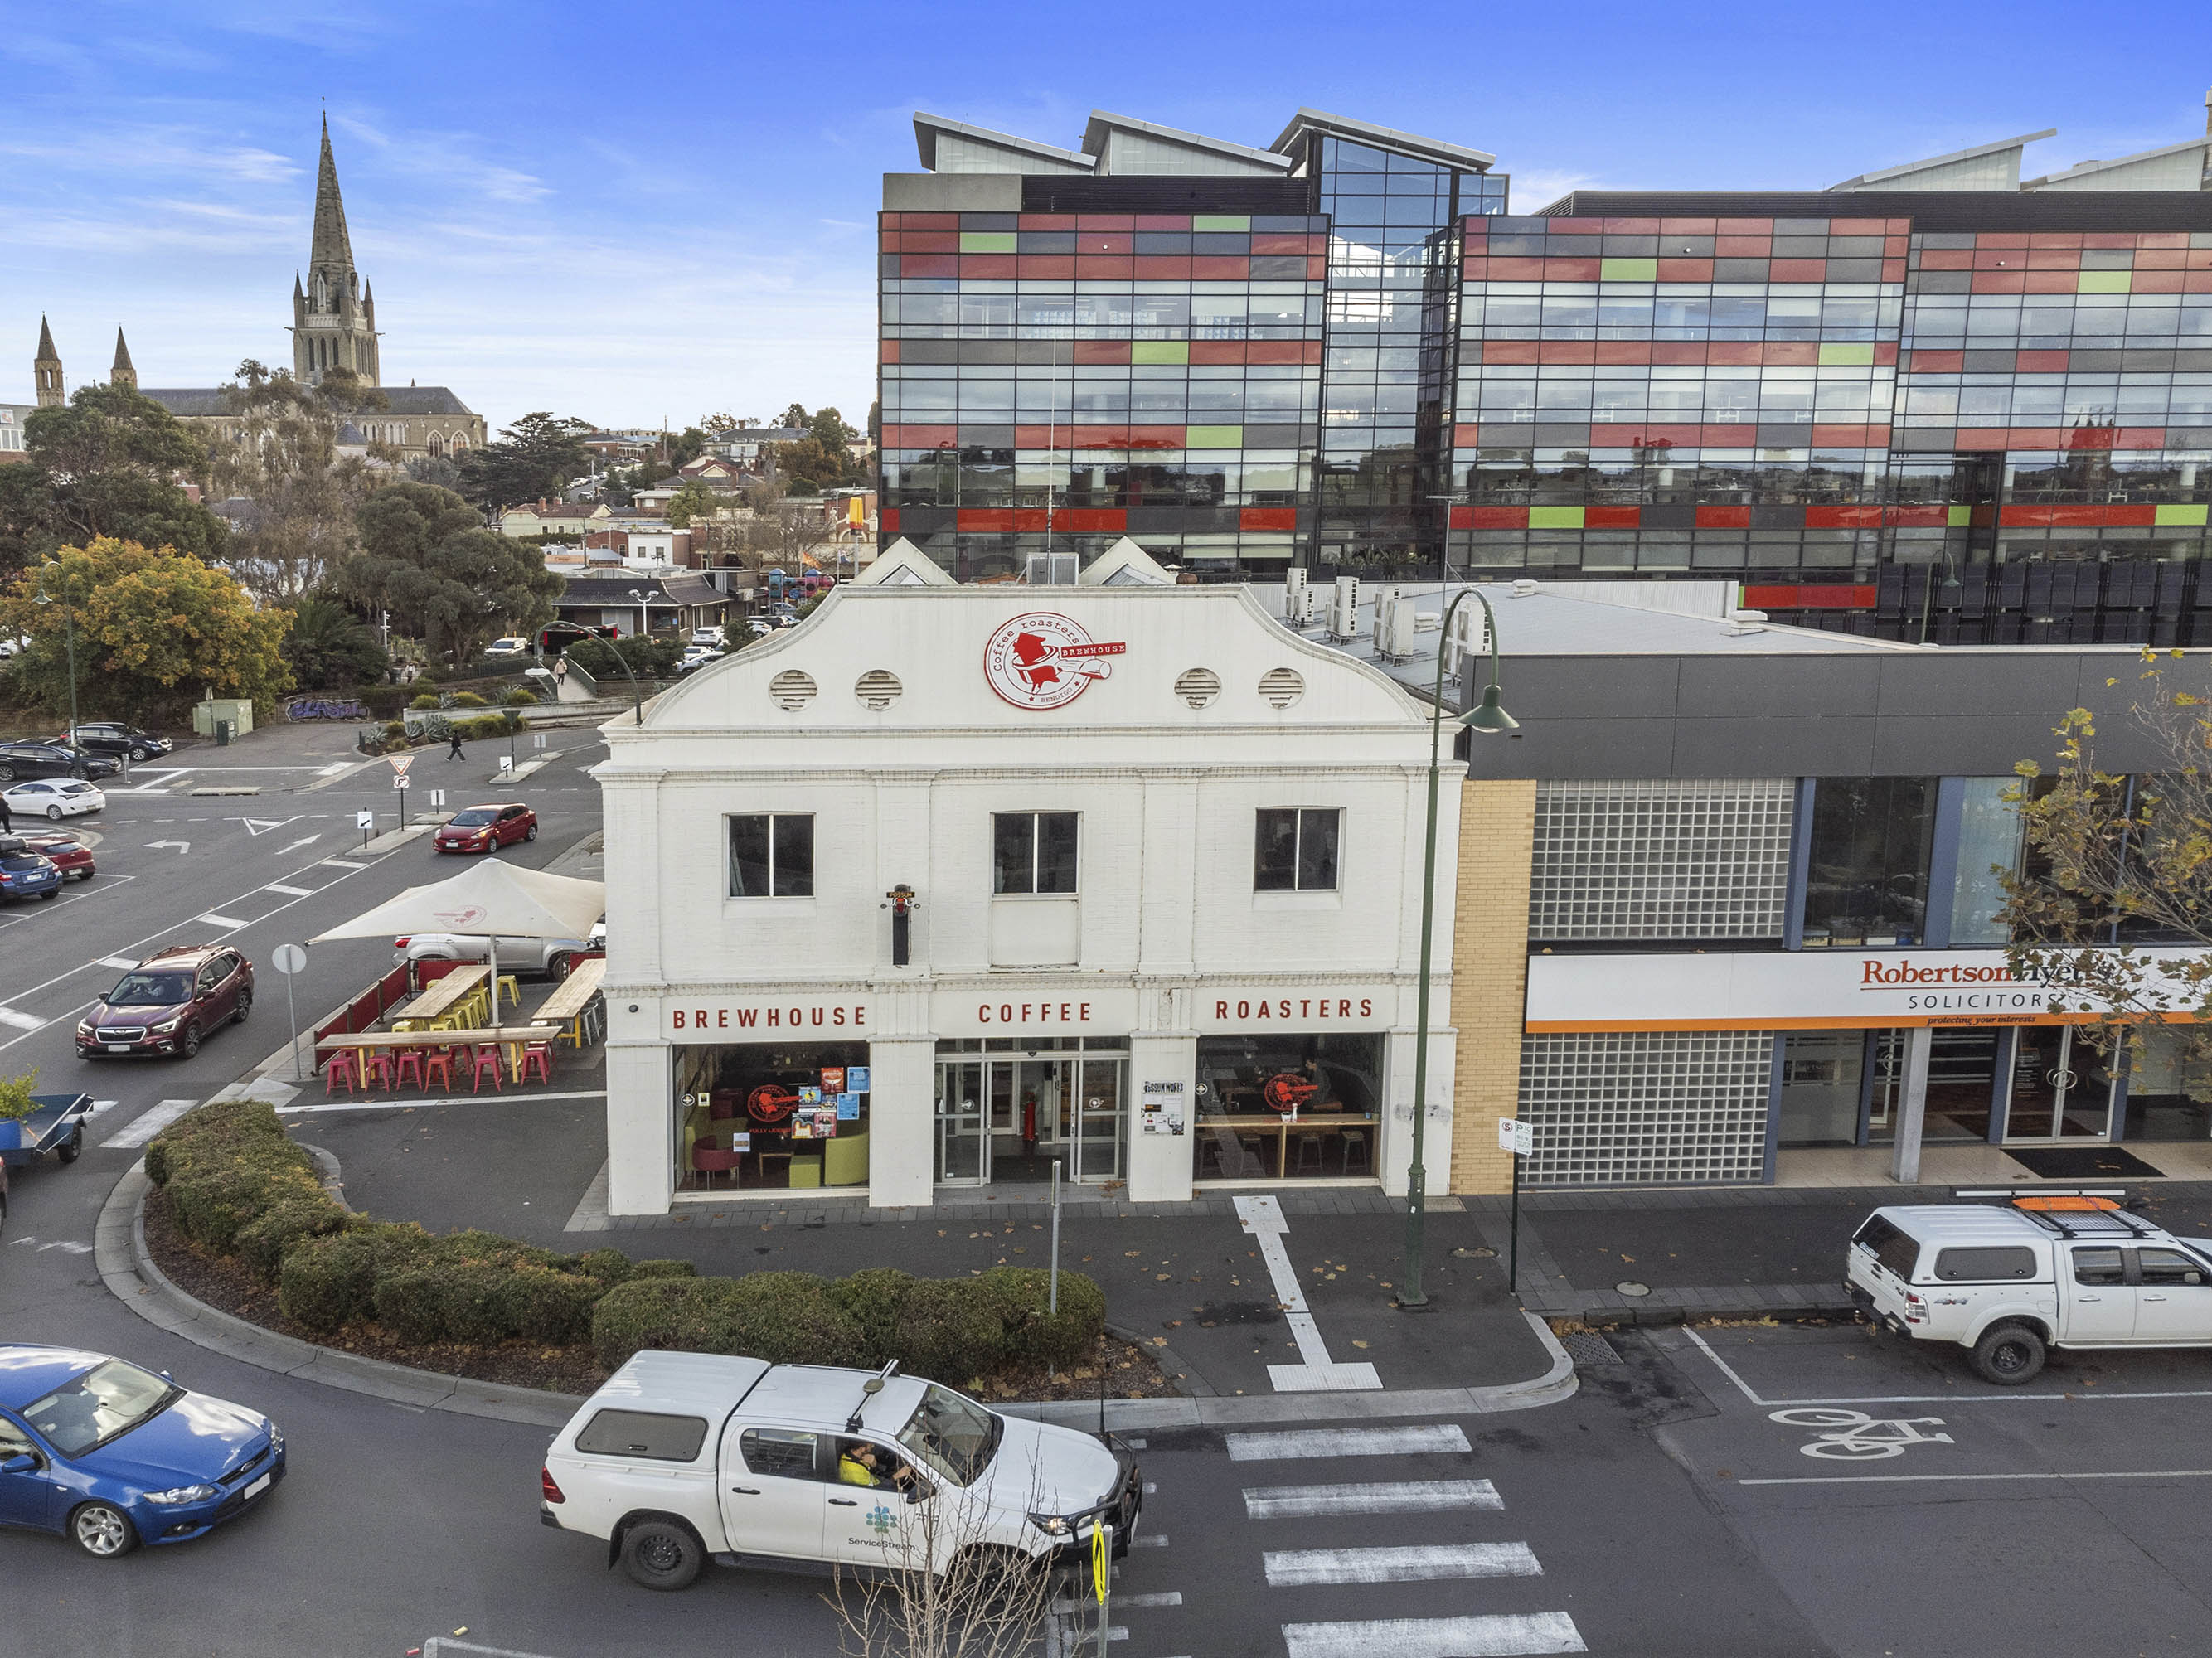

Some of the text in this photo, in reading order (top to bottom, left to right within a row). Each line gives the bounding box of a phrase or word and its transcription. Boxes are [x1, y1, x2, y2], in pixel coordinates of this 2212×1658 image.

[993, 619, 1080, 671] Coffee roasters
[1062, 644, 1126, 657] BREWHOUSE
[1041, 687, 1073, 703] BENDIGO
[1909, 993, 2058, 1009] SOLICITORS
[673, 998, 1372, 1029] BREWHOUSE COFFEE ROASTERS
[1927, 1015, 2036, 1026] protecting your interests
[848, 1537, 916, 1551] ServiceStream
